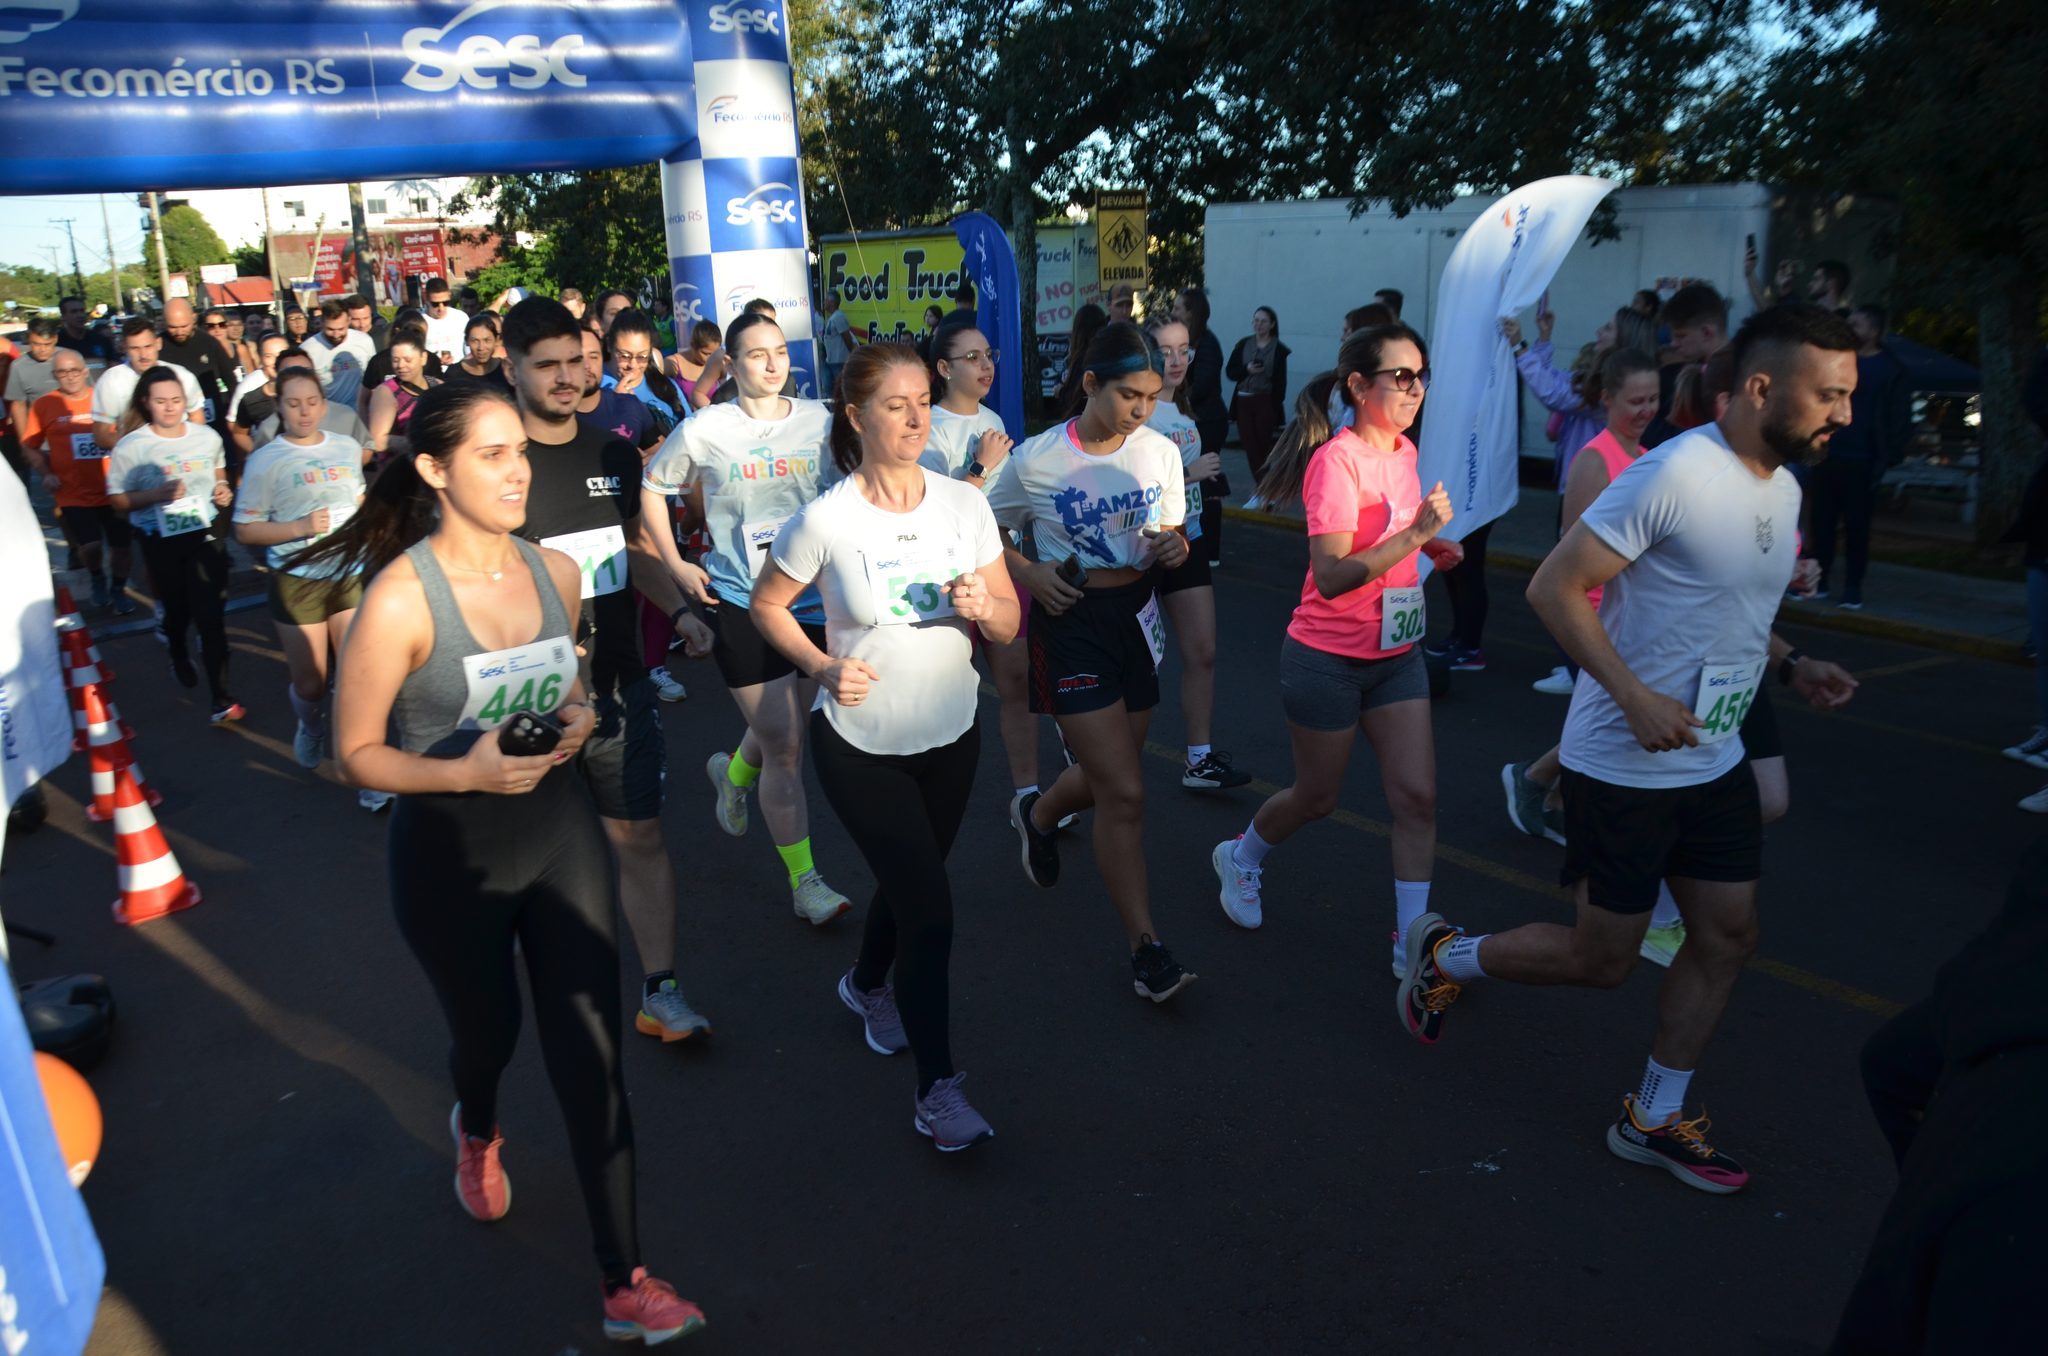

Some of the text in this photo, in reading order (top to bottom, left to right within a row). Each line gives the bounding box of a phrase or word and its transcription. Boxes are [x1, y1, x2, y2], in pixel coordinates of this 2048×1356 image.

[709, 5, 779, 36] Sesc
[402, 26, 587, 92] Sesc
[0, 56, 346, 98] Fecomércio RS
[714, 111, 780, 124] Fecoércio
[1100, 194, 1143, 207] DEVAGAR
[687, 210, 703, 222] RS
[726, 197, 797, 226] Sesc
[829, 252, 890, 301] Food
[1102, 266, 1145, 282] ELEVADA
[1045, 281, 1075, 300] NO
[674, 299, 703, 321] esc
[1037, 304, 1073, 327] ETO
[586, 477, 621, 489] CTAC
[1133, 505, 1161, 525] RU
[752, 529, 776, 541] Sesc
[898, 534, 917, 542] FILA
[887, 568, 958, 616] 53
[1390, 595, 1409, 604] Sesc
[1391, 604, 1425, 643] 302
[479, 664, 506, 679] Sesc
[1709, 677, 1730, 687] Sesc
[478, 673, 563, 724] 446
[1702, 687, 1753, 736] 456
